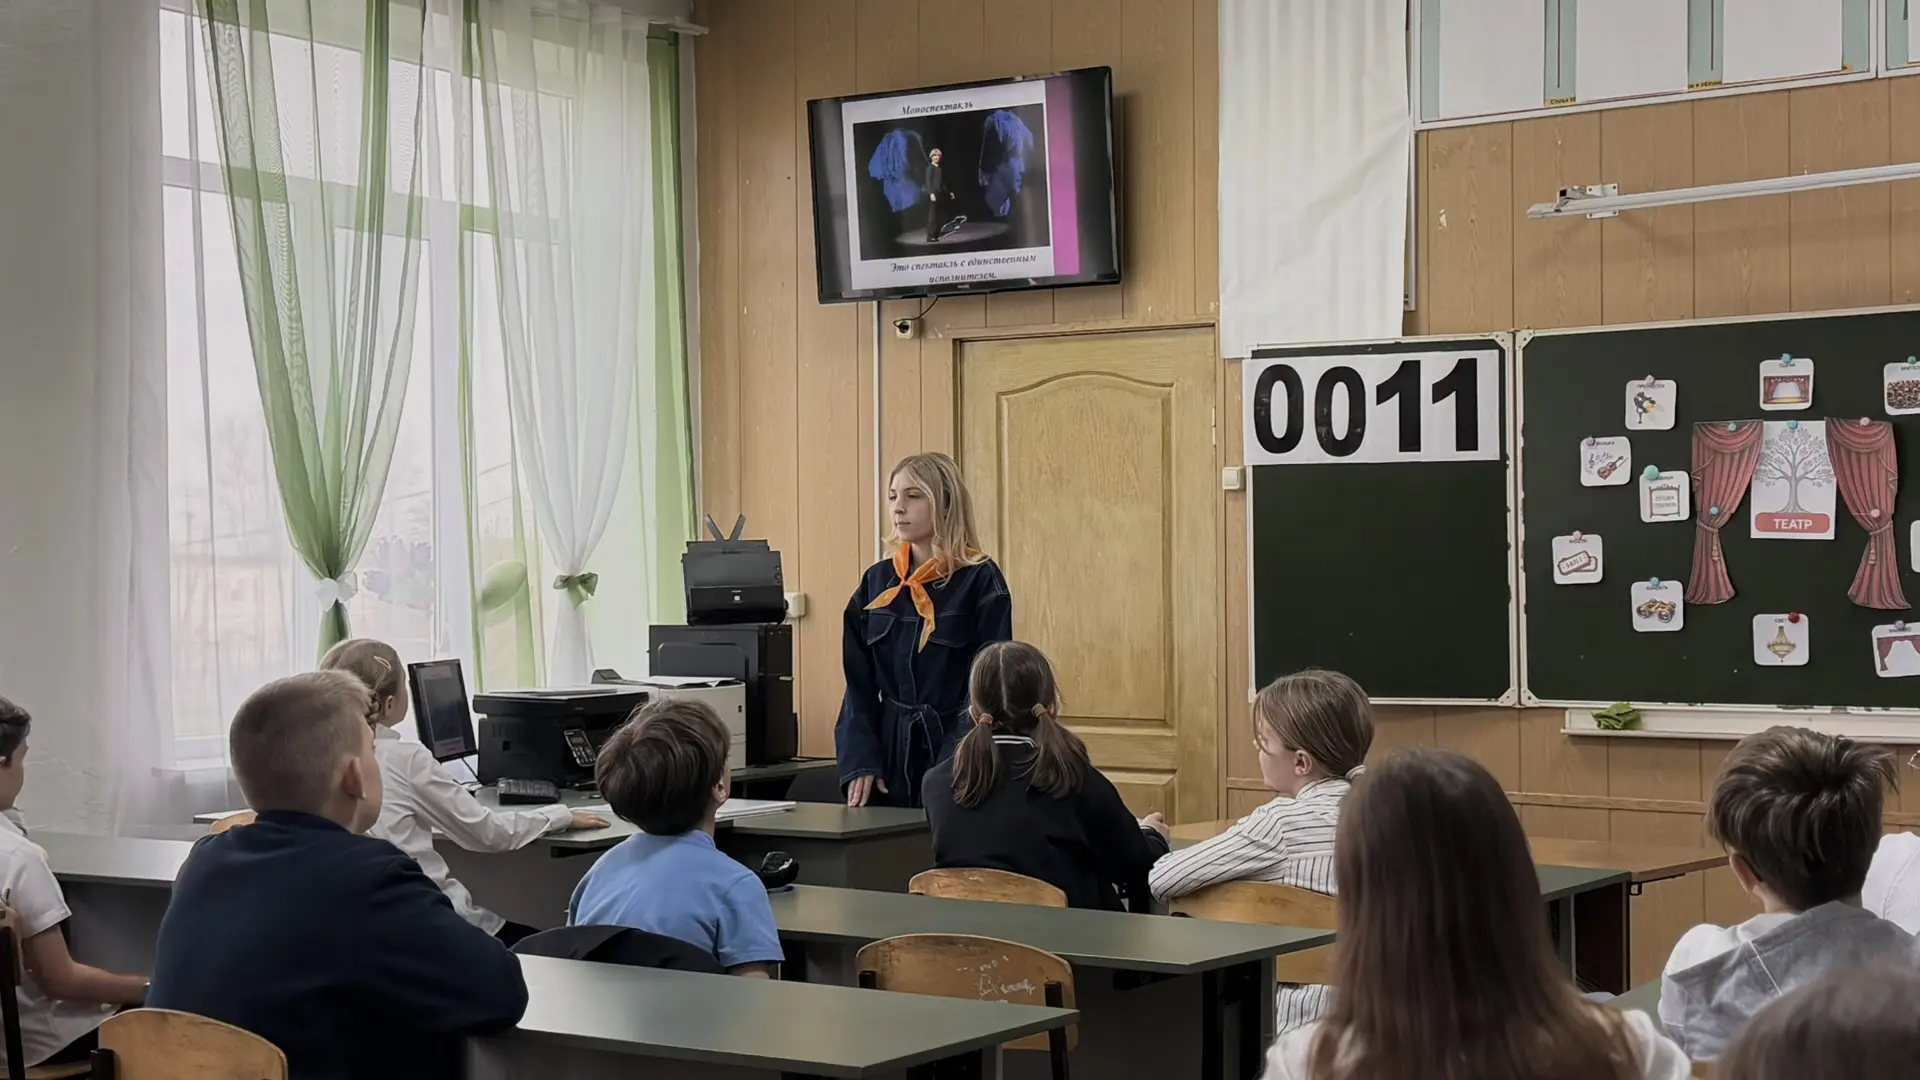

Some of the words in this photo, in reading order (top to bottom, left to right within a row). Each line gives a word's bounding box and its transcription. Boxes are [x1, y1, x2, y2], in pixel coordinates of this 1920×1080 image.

[902, 101, 974, 115] Моноспектакль
[891, 263, 909, 272] Это
[911, 261, 958, 271] спектакль
[967, 254, 1037, 267] единственным
[1253, 357, 1479, 458] 0011
[1773, 518, 1813, 530] ТЕАТР
